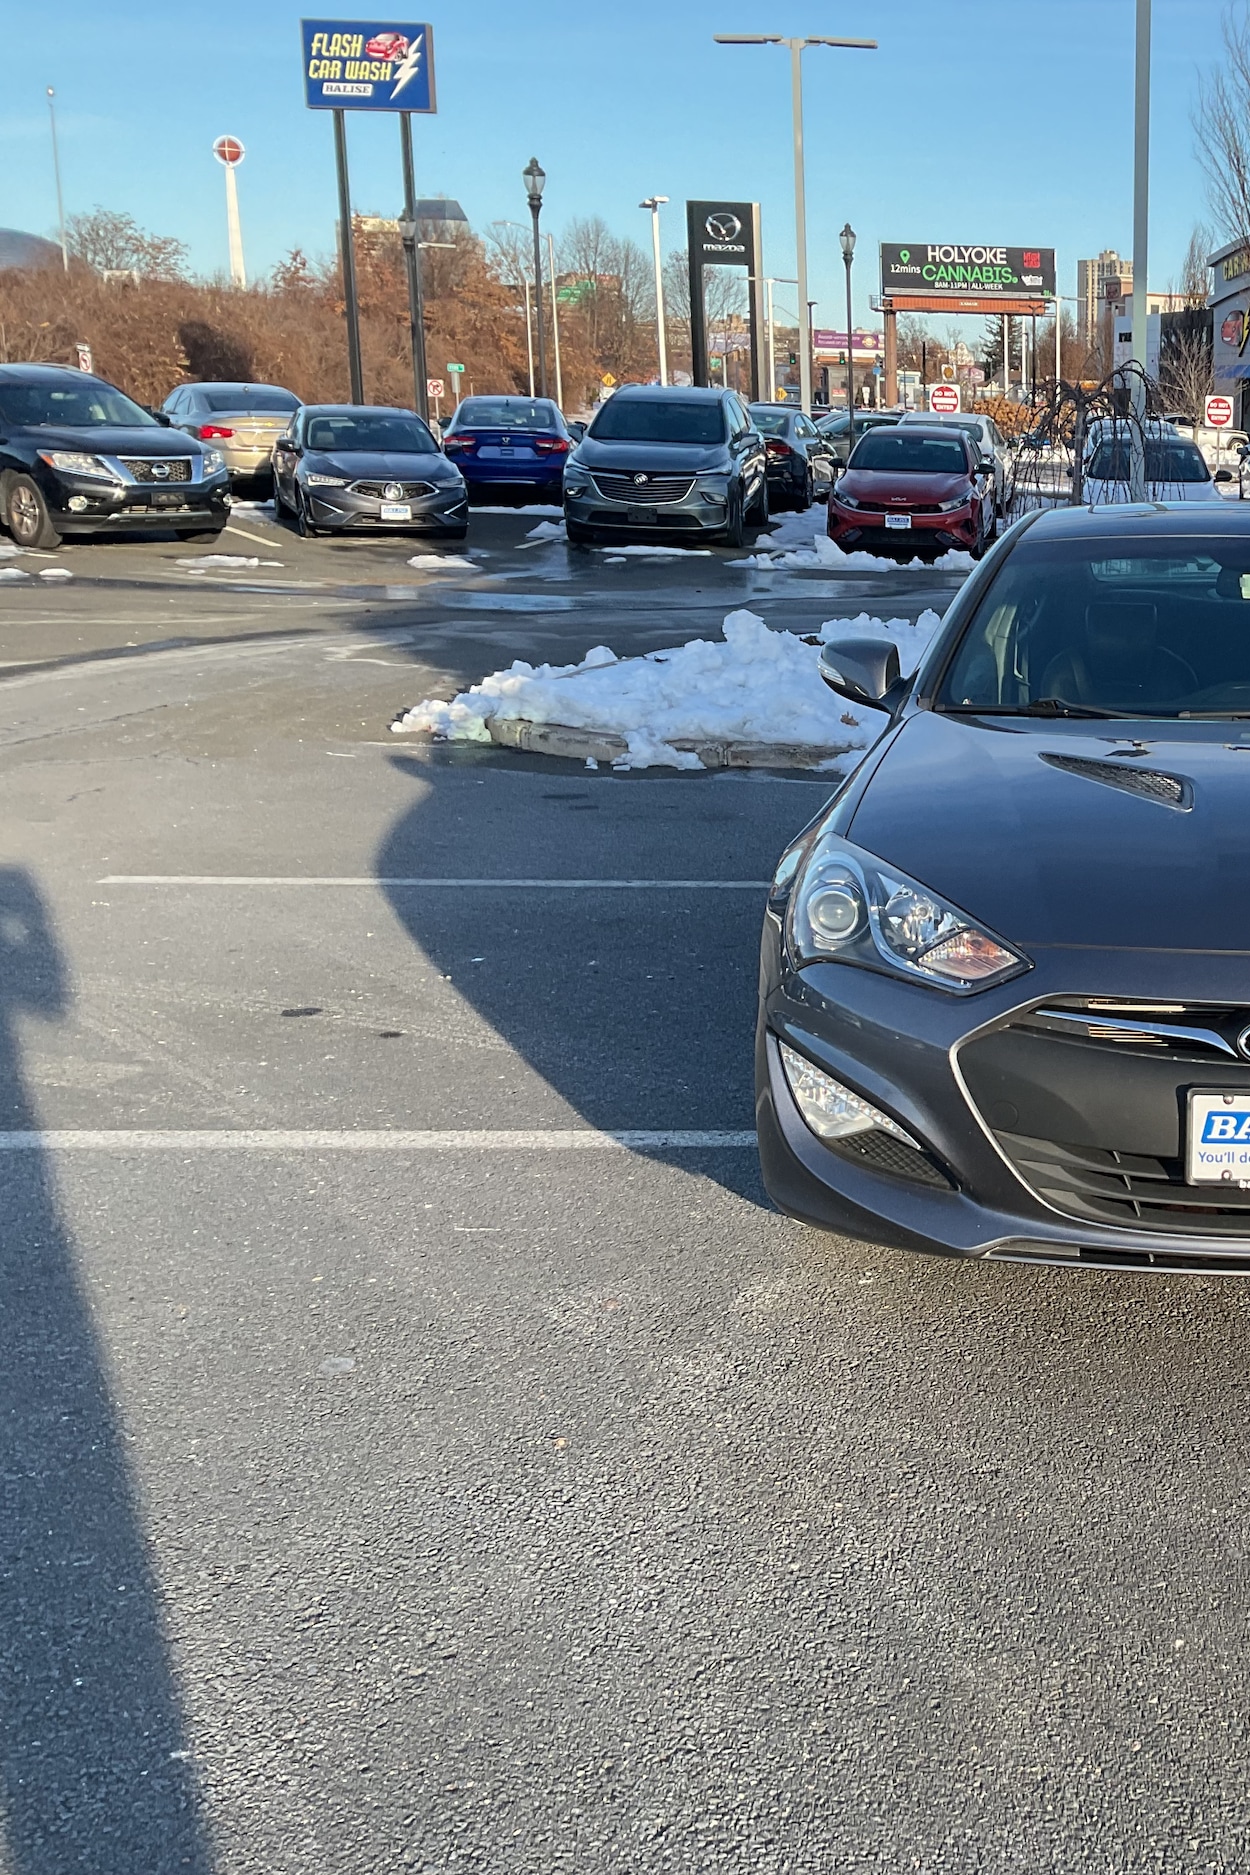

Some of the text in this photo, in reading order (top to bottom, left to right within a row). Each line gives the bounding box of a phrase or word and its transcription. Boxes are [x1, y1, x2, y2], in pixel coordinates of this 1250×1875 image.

[311, 33, 363, 57] FLASH
[308, 59, 392, 81] CAR WASH
[325, 84, 370, 94] BALISE
[927, 245, 1007, 264] HOLYOKE
[891, 264, 921, 274] 12mins
[1199, 1152, 1234, 1164] You'll
